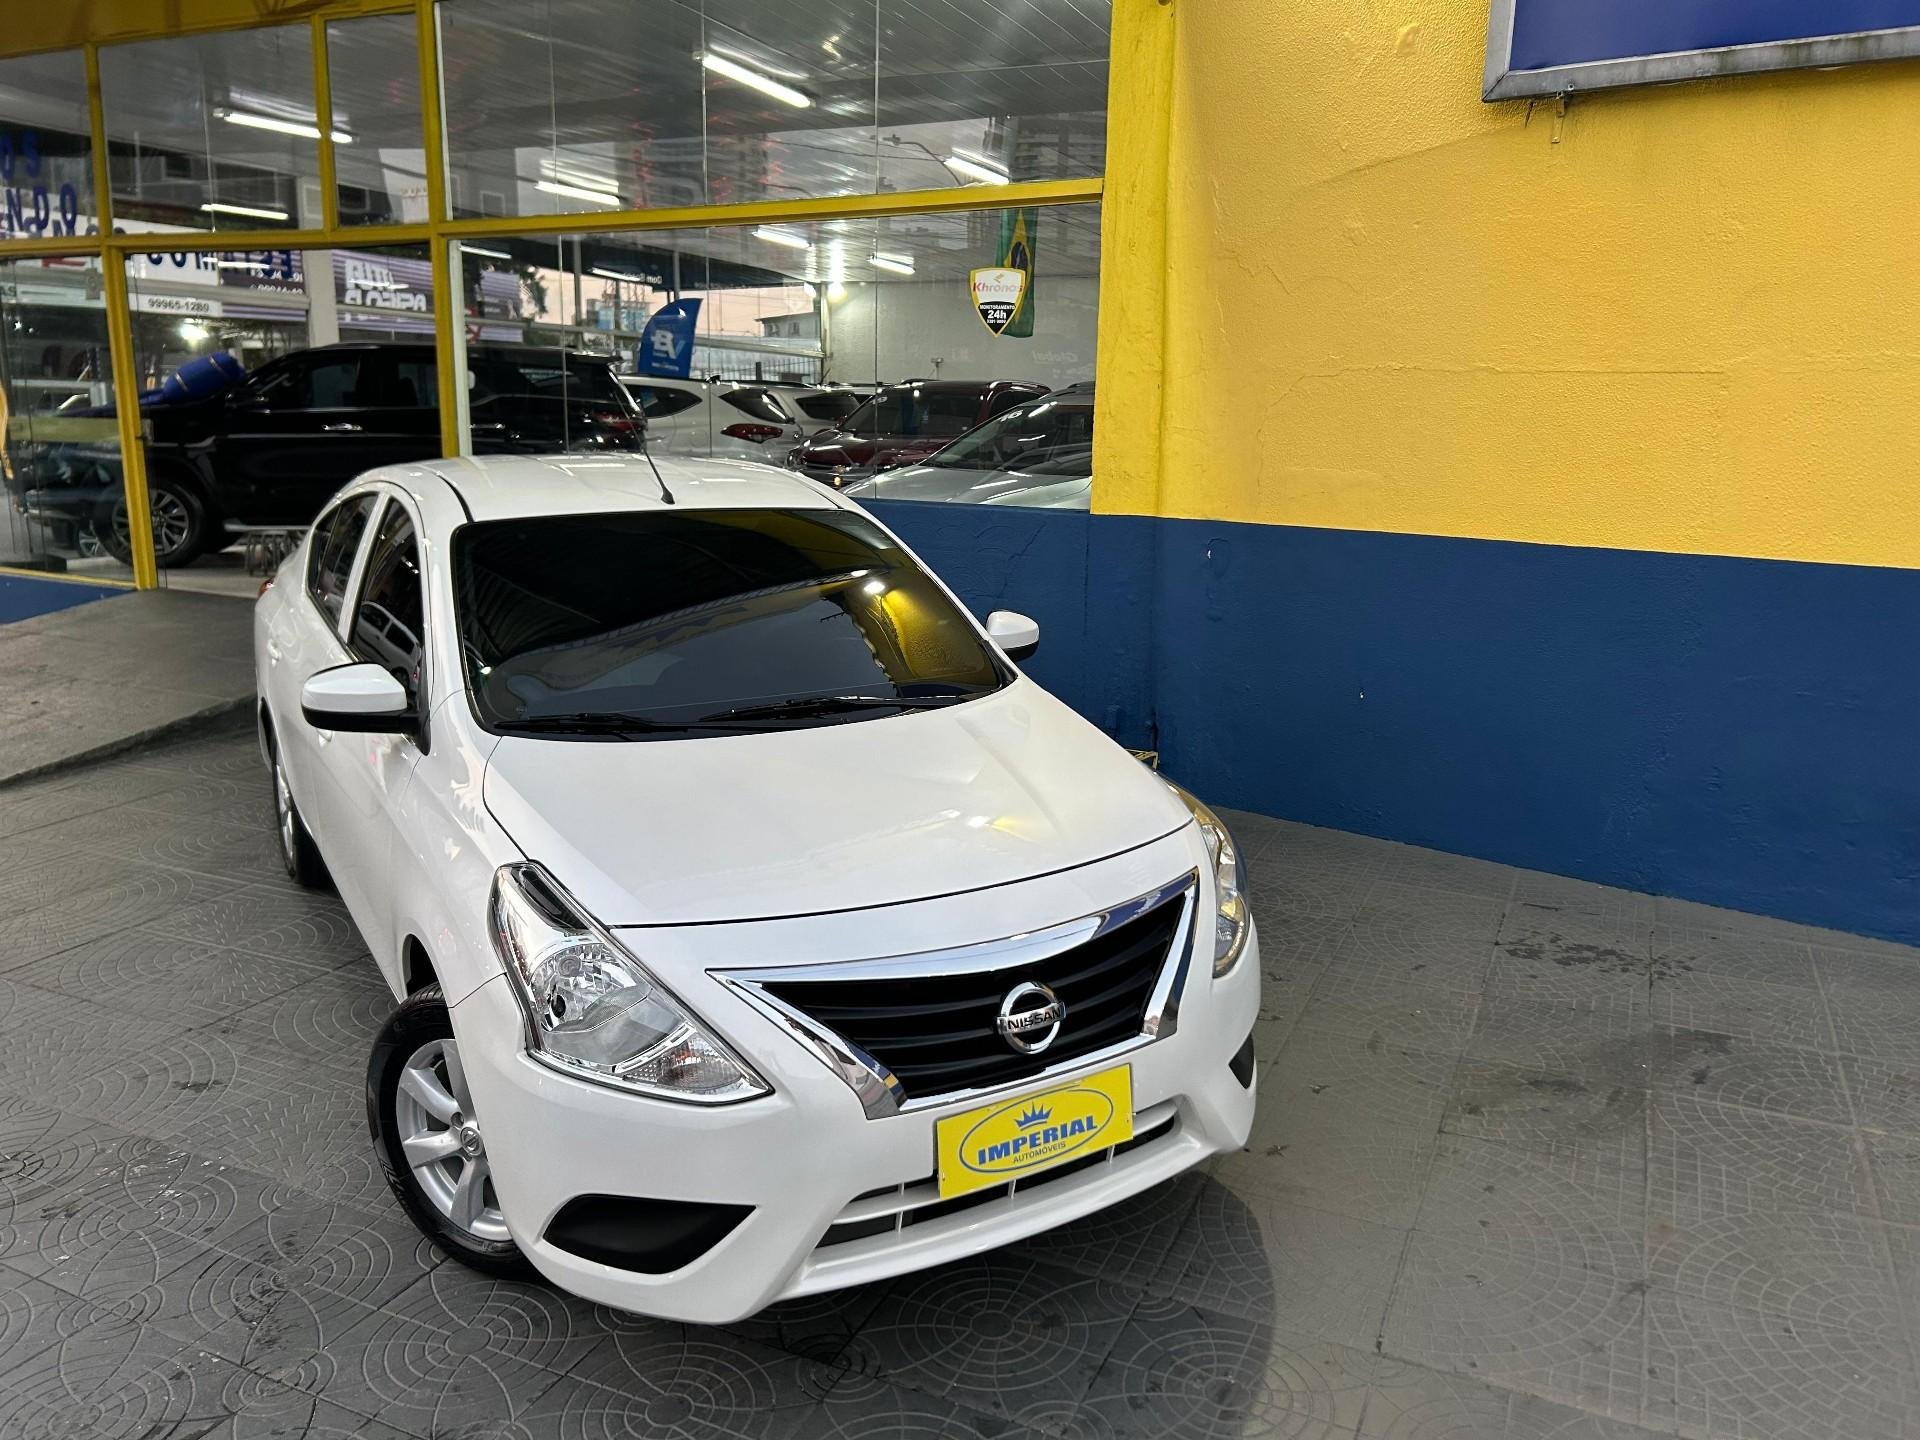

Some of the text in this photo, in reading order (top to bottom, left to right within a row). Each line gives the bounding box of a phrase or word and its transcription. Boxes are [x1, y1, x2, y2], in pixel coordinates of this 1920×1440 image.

[973, 282, 1023, 292] Khronos
[987, 310, 1007, 319] 24h
[1007, 1005, 1060, 1030] NISSAN
[977, 1114, 1098, 1166] IMPERIAL
